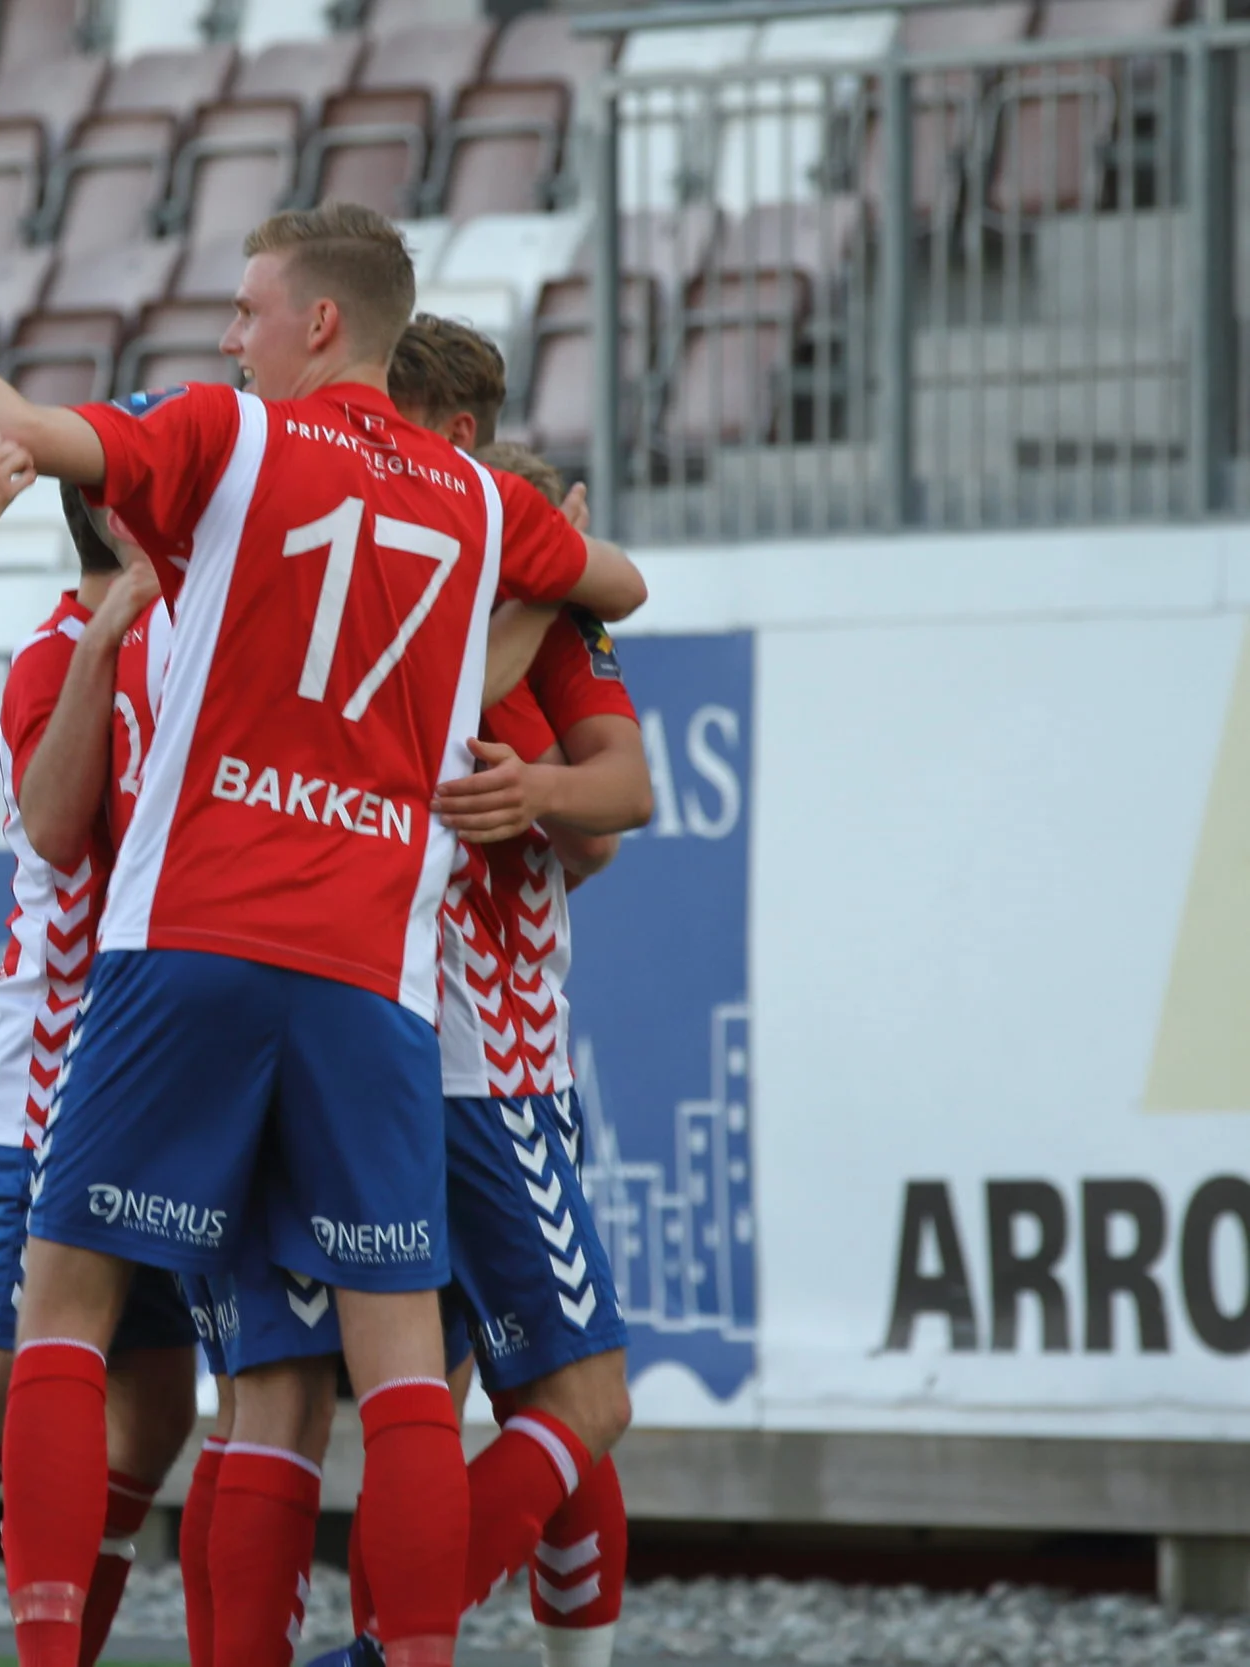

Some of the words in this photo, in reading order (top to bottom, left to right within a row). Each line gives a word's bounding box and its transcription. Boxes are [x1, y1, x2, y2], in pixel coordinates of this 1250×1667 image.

[282, 495, 461, 723] 17
[212, 754, 412, 846] BAKKEN
[124, 1190, 227, 1238] NEMUS
[338, 1220, 429, 1255] NEMUS
